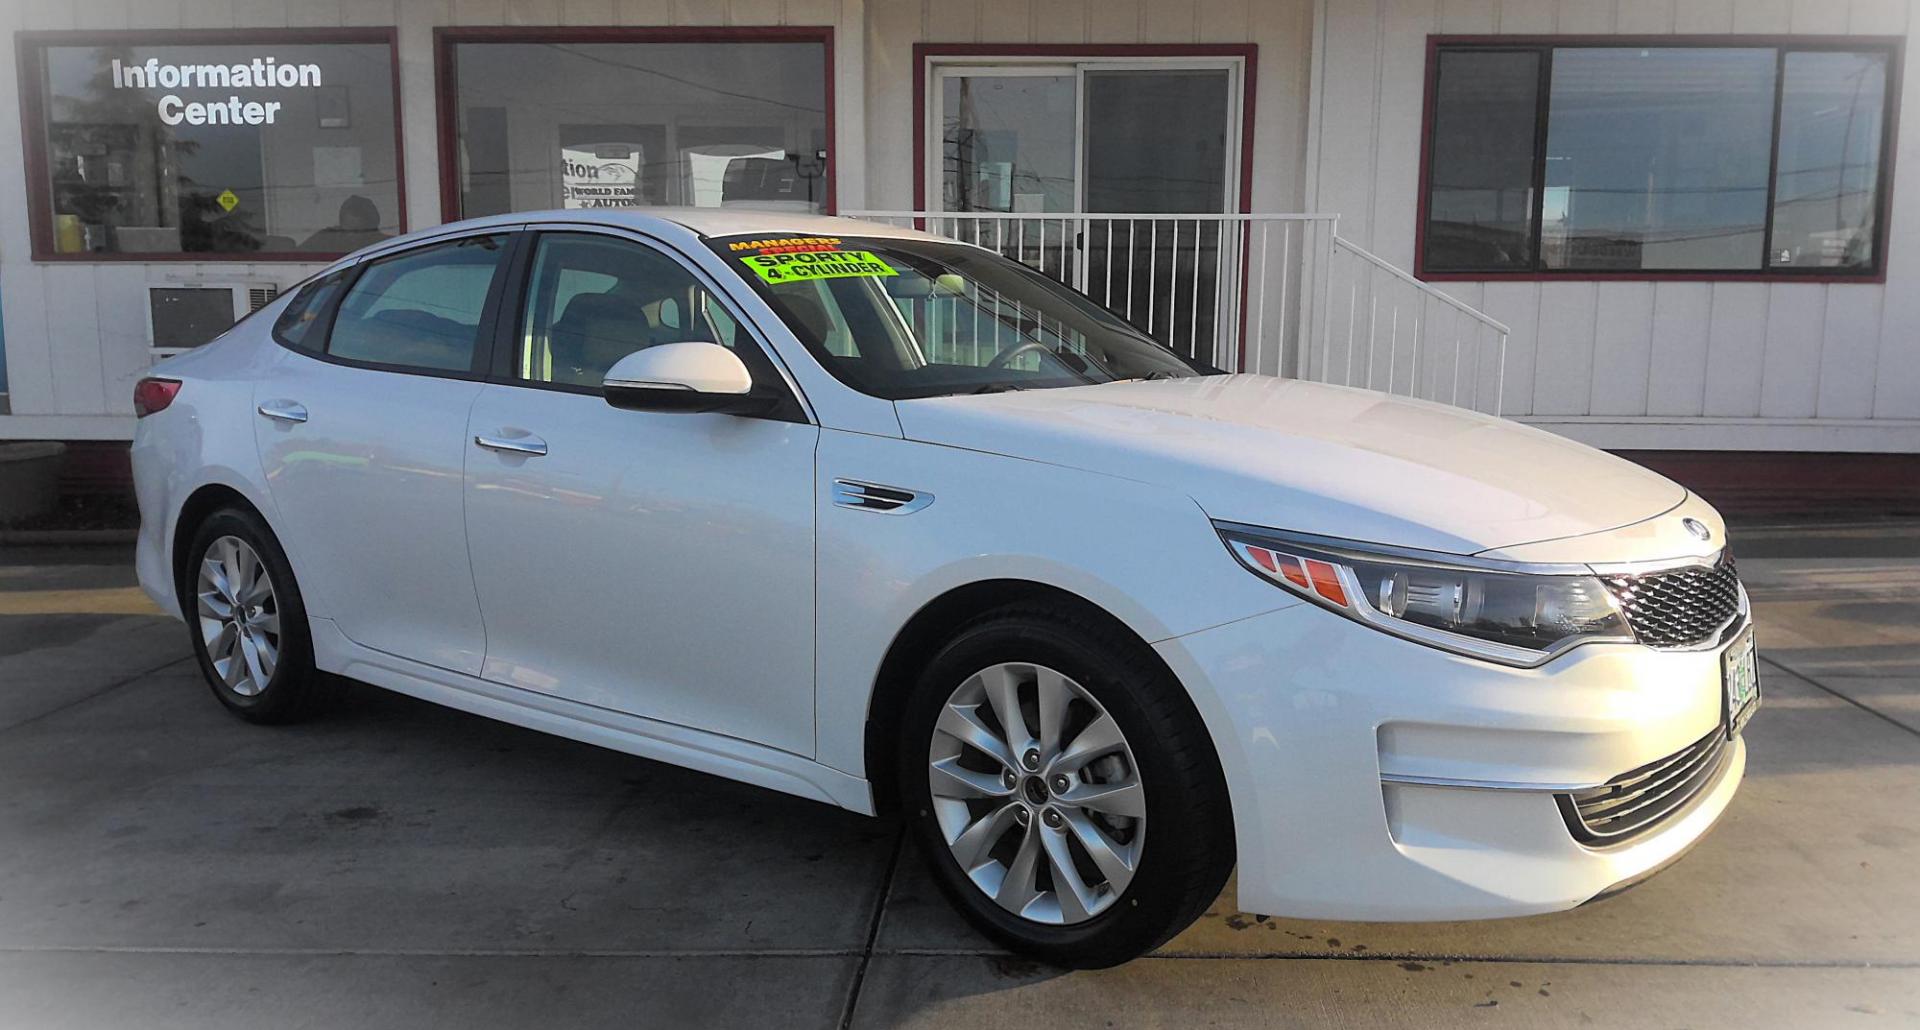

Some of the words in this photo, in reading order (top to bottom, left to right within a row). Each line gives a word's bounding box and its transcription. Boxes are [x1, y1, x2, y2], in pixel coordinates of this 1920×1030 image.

[112, 57, 322, 89] Information
[158, 95, 281, 126] Center
[575, 187, 612, 196] WORLD
[729, 237, 842, 251] MANAGERS
[754, 251, 866, 267] SPORTY
